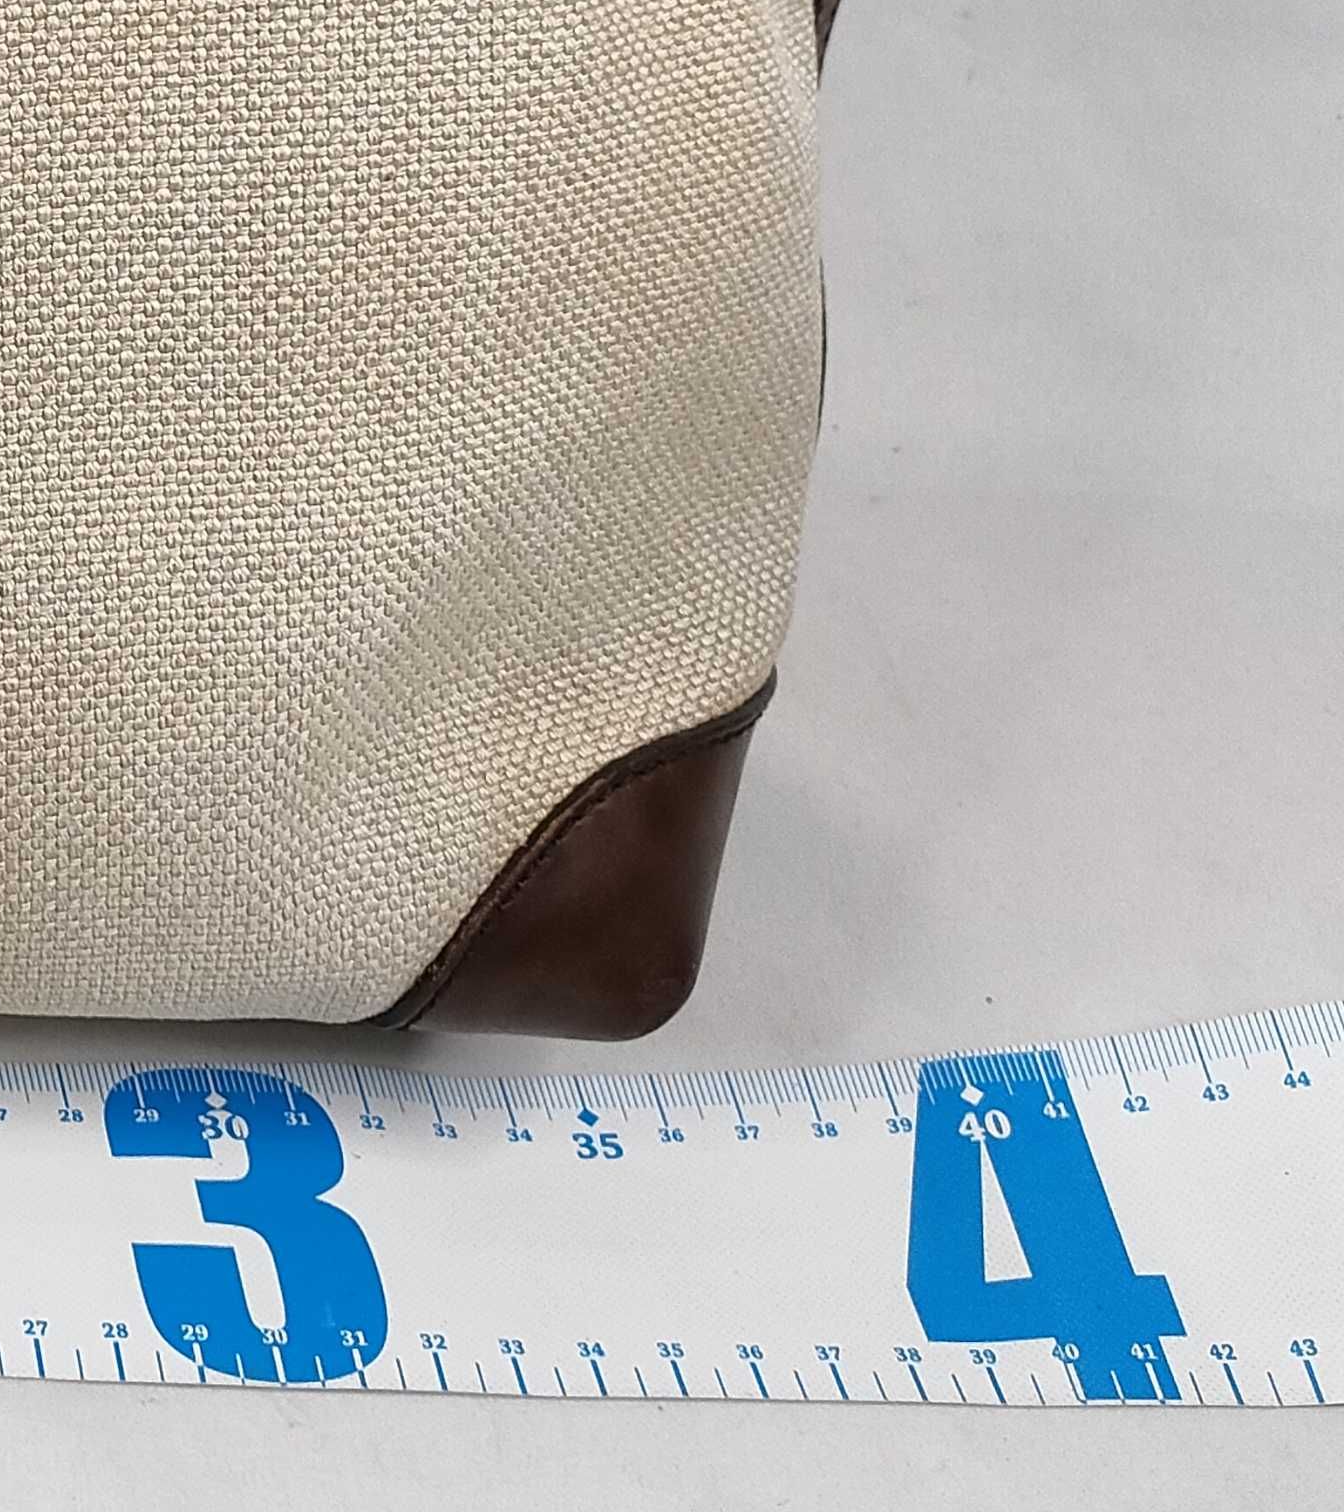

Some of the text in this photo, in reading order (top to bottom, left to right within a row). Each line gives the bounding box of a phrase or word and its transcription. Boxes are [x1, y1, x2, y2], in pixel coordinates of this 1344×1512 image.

[59, 1109, 84, 1122] 28
[134, 1109, 159, 1123] 29
[200, 1113, 250, 1141] 30
[285, 1110, 311, 1127] 31
[361, 1114, 386, 1130] 32
[433, 1123, 458, 1138] 33
[507, 1127, 533, 1143] 34
[573, 1132, 624, 1160] 35
[658, 1128, 684, 1143] 36
[734, 1125, 760, 1141] 37
[812, 1122, 838, 1138] 38
[886, 1117, 913, 1135] 39
[958, 1108, 1011, 1141] 40
[1043, 1102, 1070, 1119] 41
[1123, 1096, 1150, 1113] 42
[1202, 1084, 1229, 1102] 43
[1283, 1071, 1311, 1089] 44
[103, 1067, 389, 1382] 3
[907, 1049, 1187, 1400] 4
[23, 1320, 48, 1335] 27
[103, 1323, 129, 1338] 28
[181, 1324, 208, 1341] 29
[260, 1327, 287, 1345] 30
[341, 1330, 369, 1347] 31
[420, 1333, 448, 1350] 32
[499, 1338, 527, 1356] 33
[577, 1341, 605, 1358] 34
[657, 1342, 685, 1358] 35
[736, 1344, 764, 1360] 36
[816, 1345, 843, 1361] 37
[894, 1346, 922, 1363] 38
[970, 1347, 998, 1365] 39
[1051, 1342, 1080, 1360] 40
[1131, 1342, 1158, 1360] 41
[1209, 1343, 1237, 1360] 42
[1290, 1338, 1318, 1356] 43
